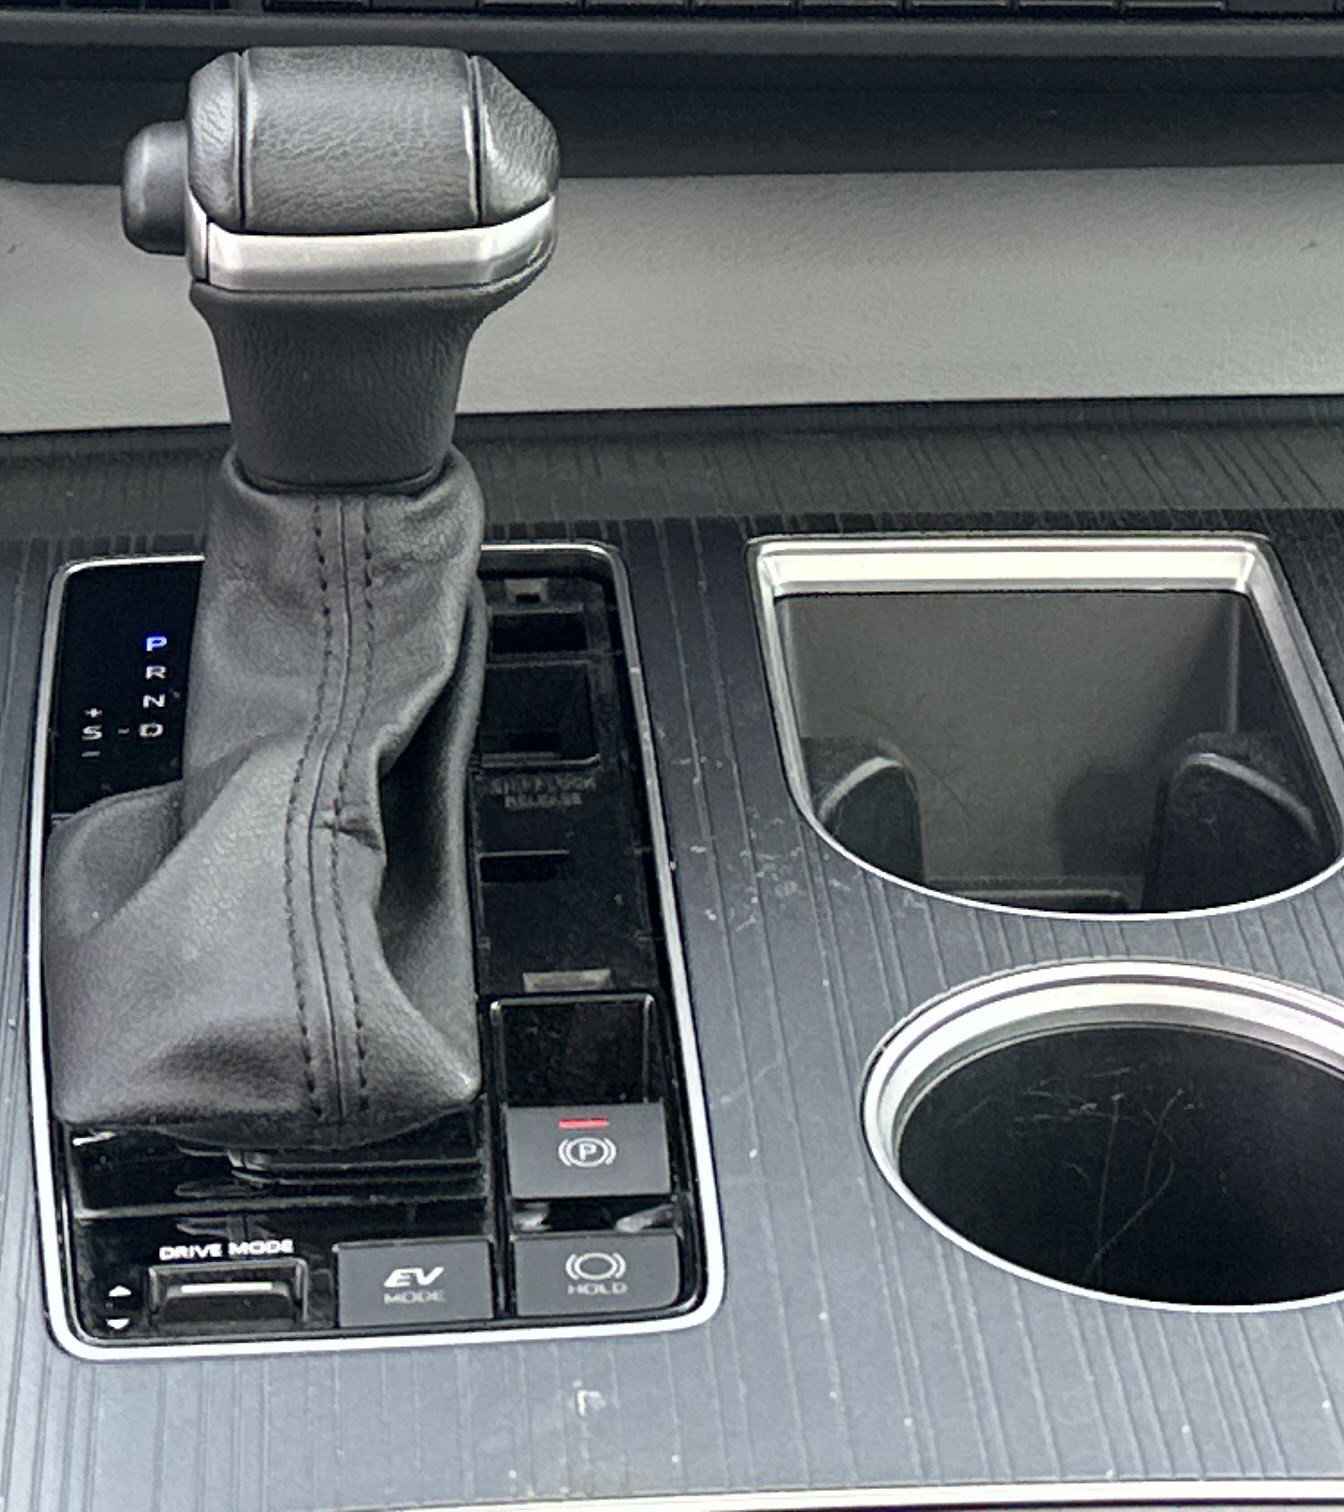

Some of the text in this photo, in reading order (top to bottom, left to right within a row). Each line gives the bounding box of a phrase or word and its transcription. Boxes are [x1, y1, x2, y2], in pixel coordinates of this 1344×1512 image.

[146, 636, 168, 652] P
[145, 665, 168, 680] R
[143, 694, 166, 708] N
[82, 723, 164, 741] S D
[159, 1239, 294, 1261] DRIVE MODE
[383, 1266, 445, 1288] EV
[567, 1283, 628, 1296] HOLD
[383, 1291, 446, 1305] MODE
